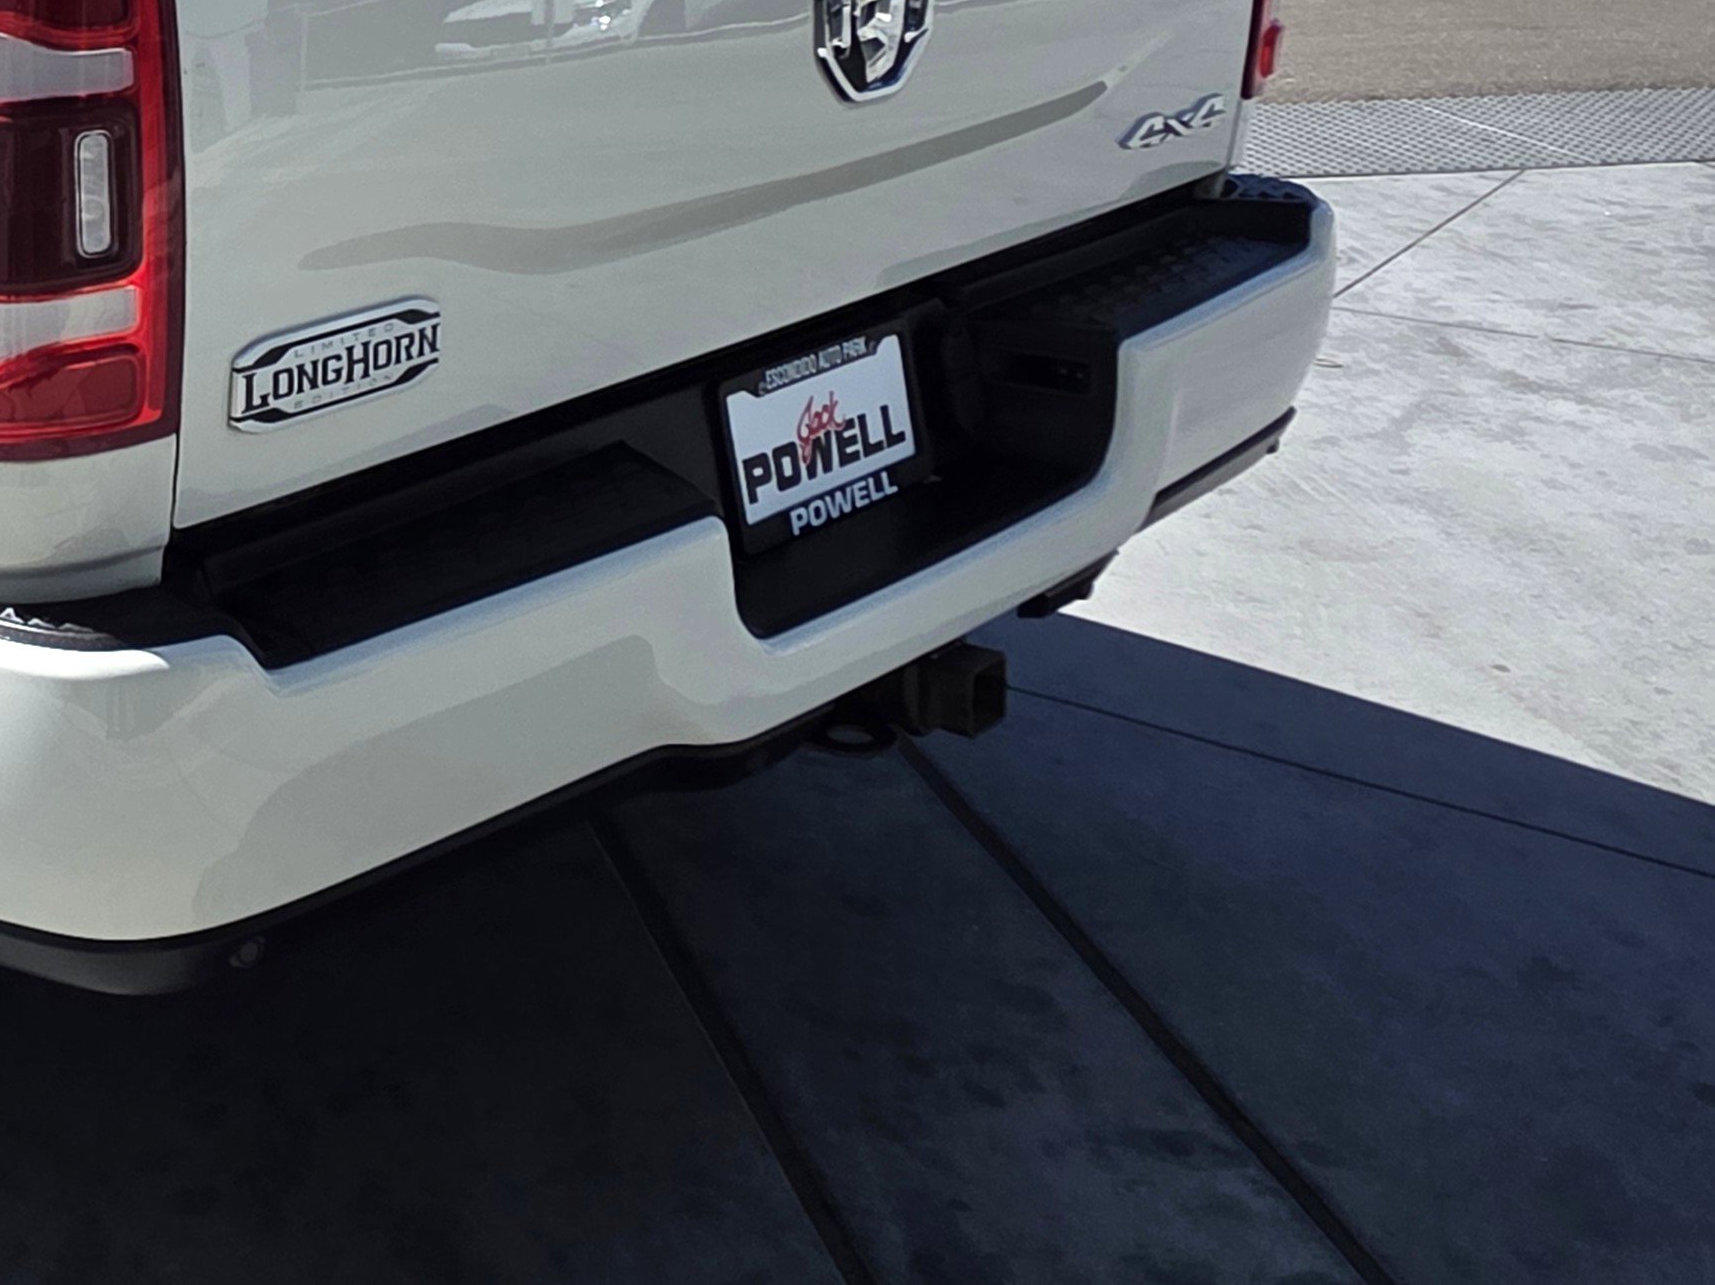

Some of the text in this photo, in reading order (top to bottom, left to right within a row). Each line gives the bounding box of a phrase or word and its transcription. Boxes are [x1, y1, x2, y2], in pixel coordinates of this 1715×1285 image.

[294, 322, 395, 359] LIMITED
[818, 344, 842, 369] AUTO
[841, 336, 867, 360] PARK
[294, 374, 394, 410] EDITION
[742, 404, 906, 505] POWELL
[789, 471, 899, 537] POWELL
